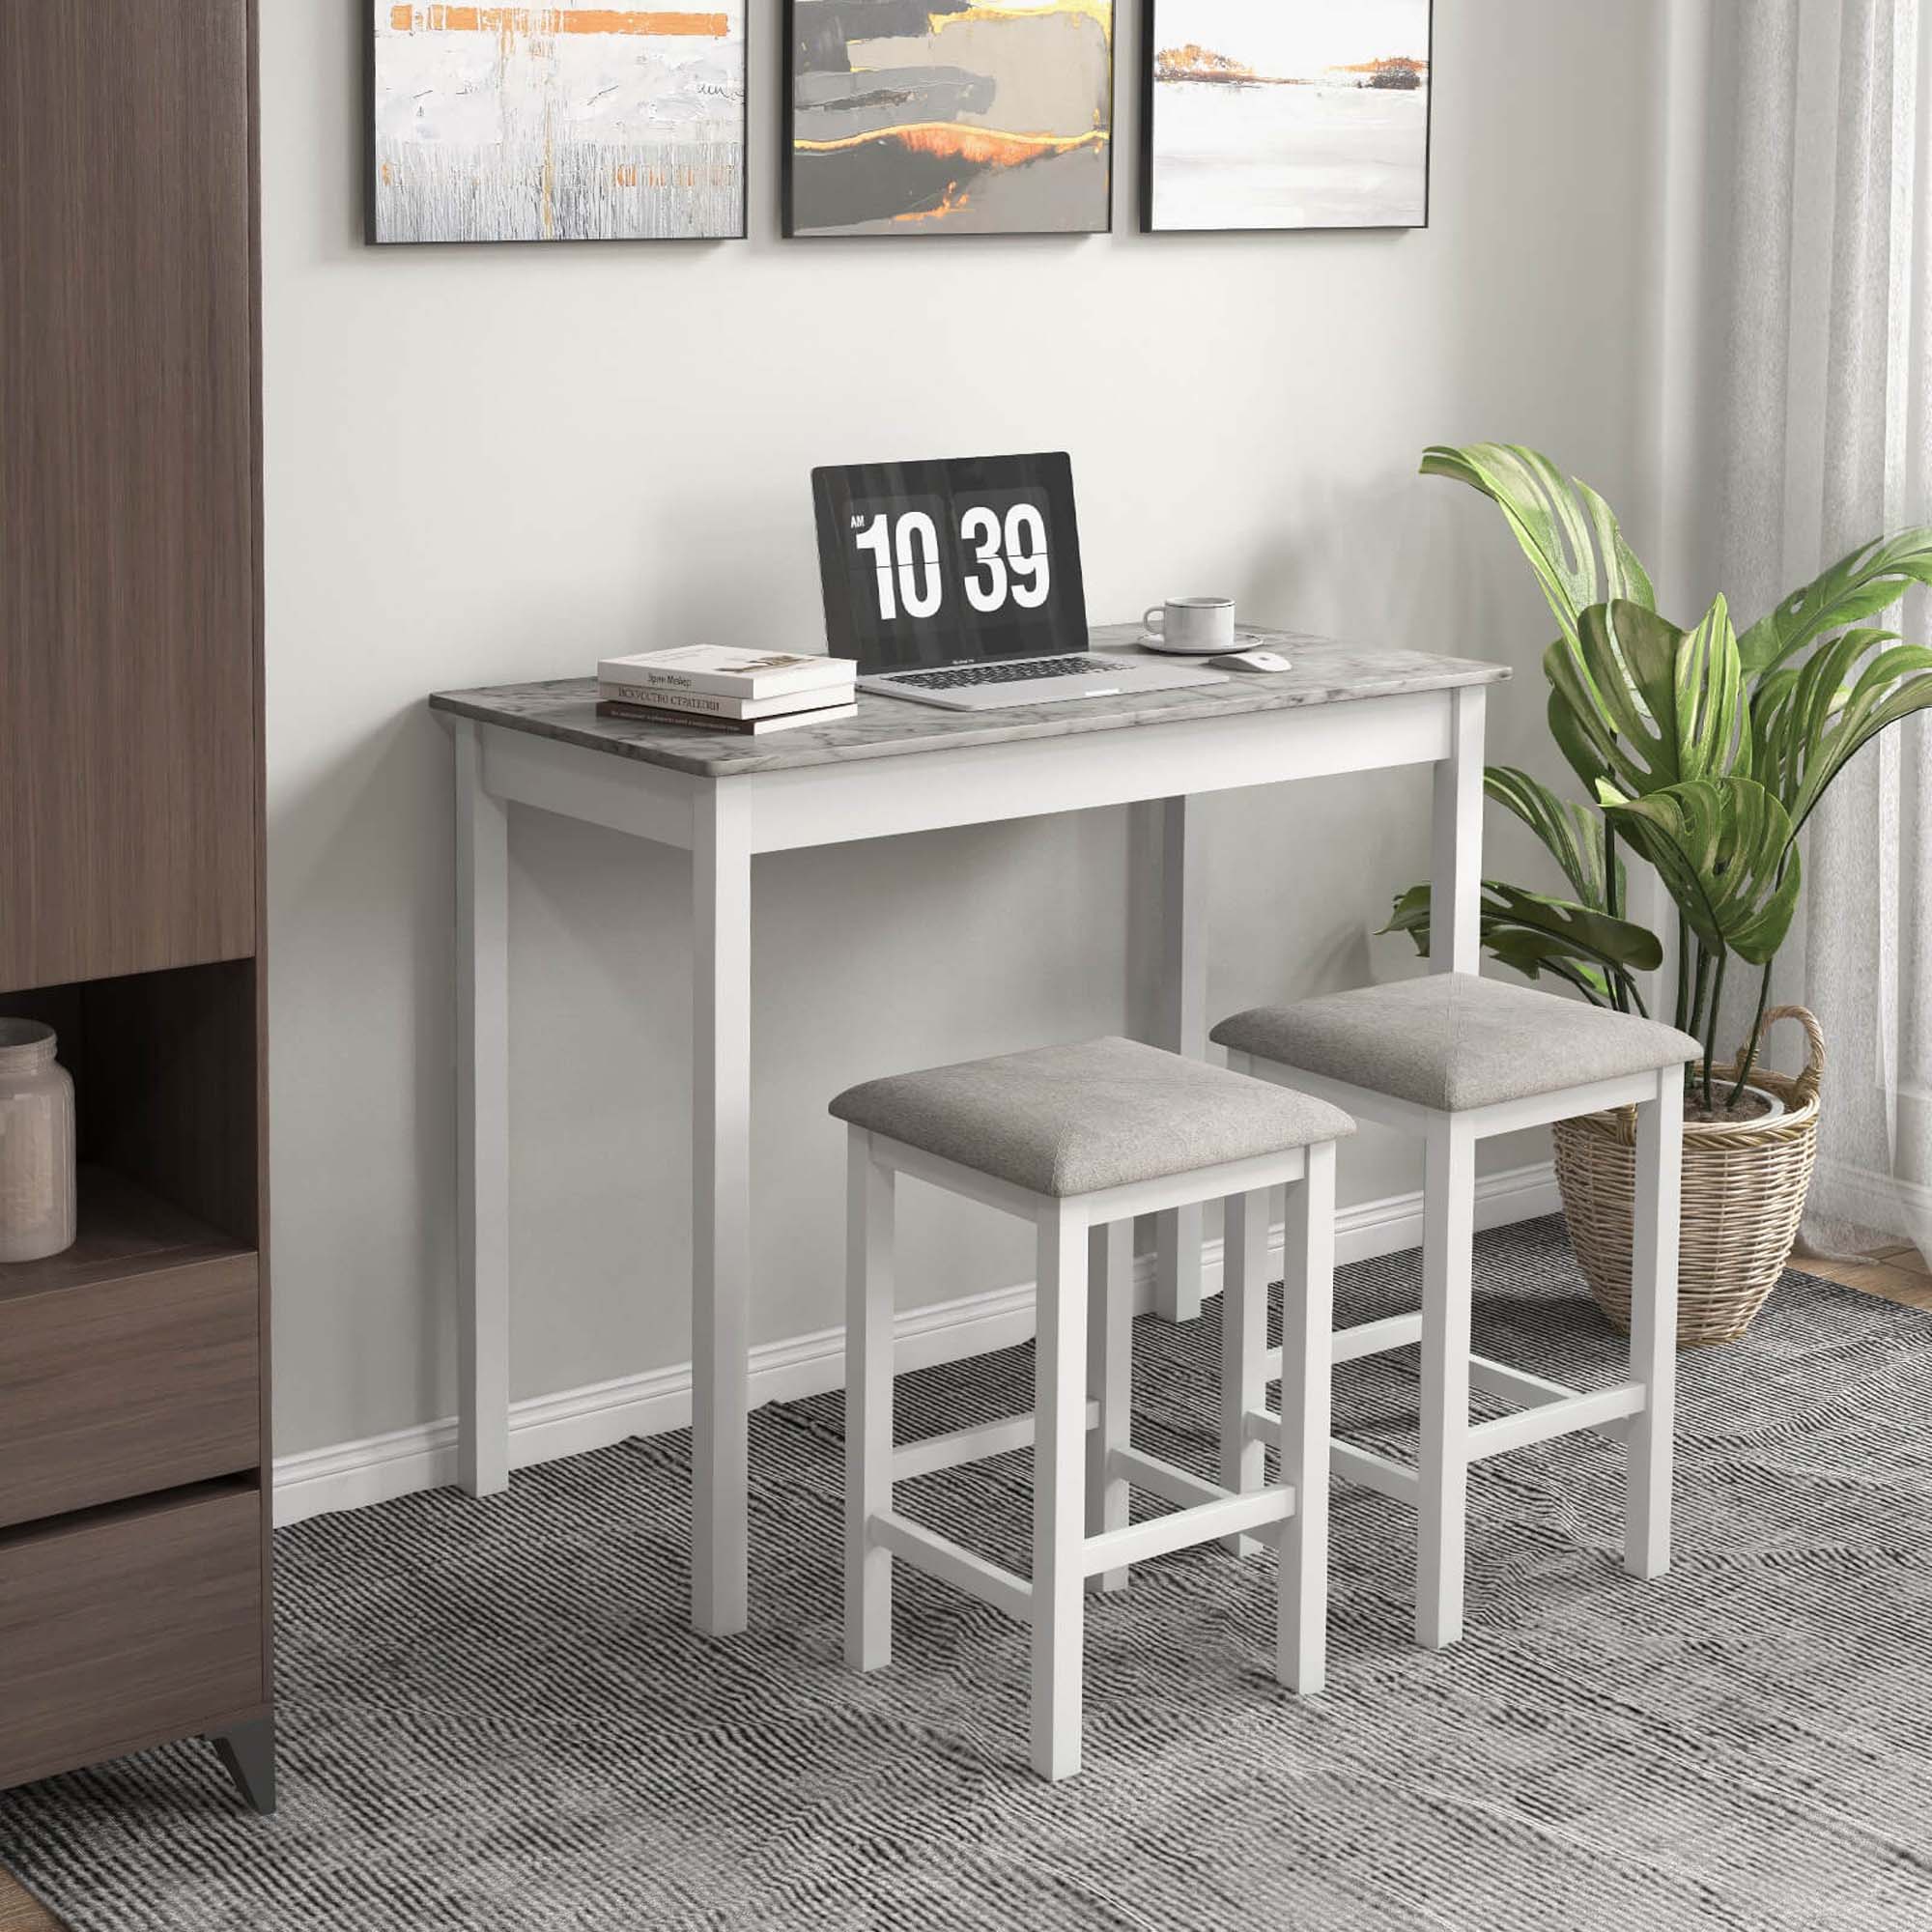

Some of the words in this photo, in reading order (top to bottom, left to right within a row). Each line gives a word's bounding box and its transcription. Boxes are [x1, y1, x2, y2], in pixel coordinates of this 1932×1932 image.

[850, 515, 865, 528] AM
[856, 511, 943, 619] 10
[960, 503, 1050, 612] 39
